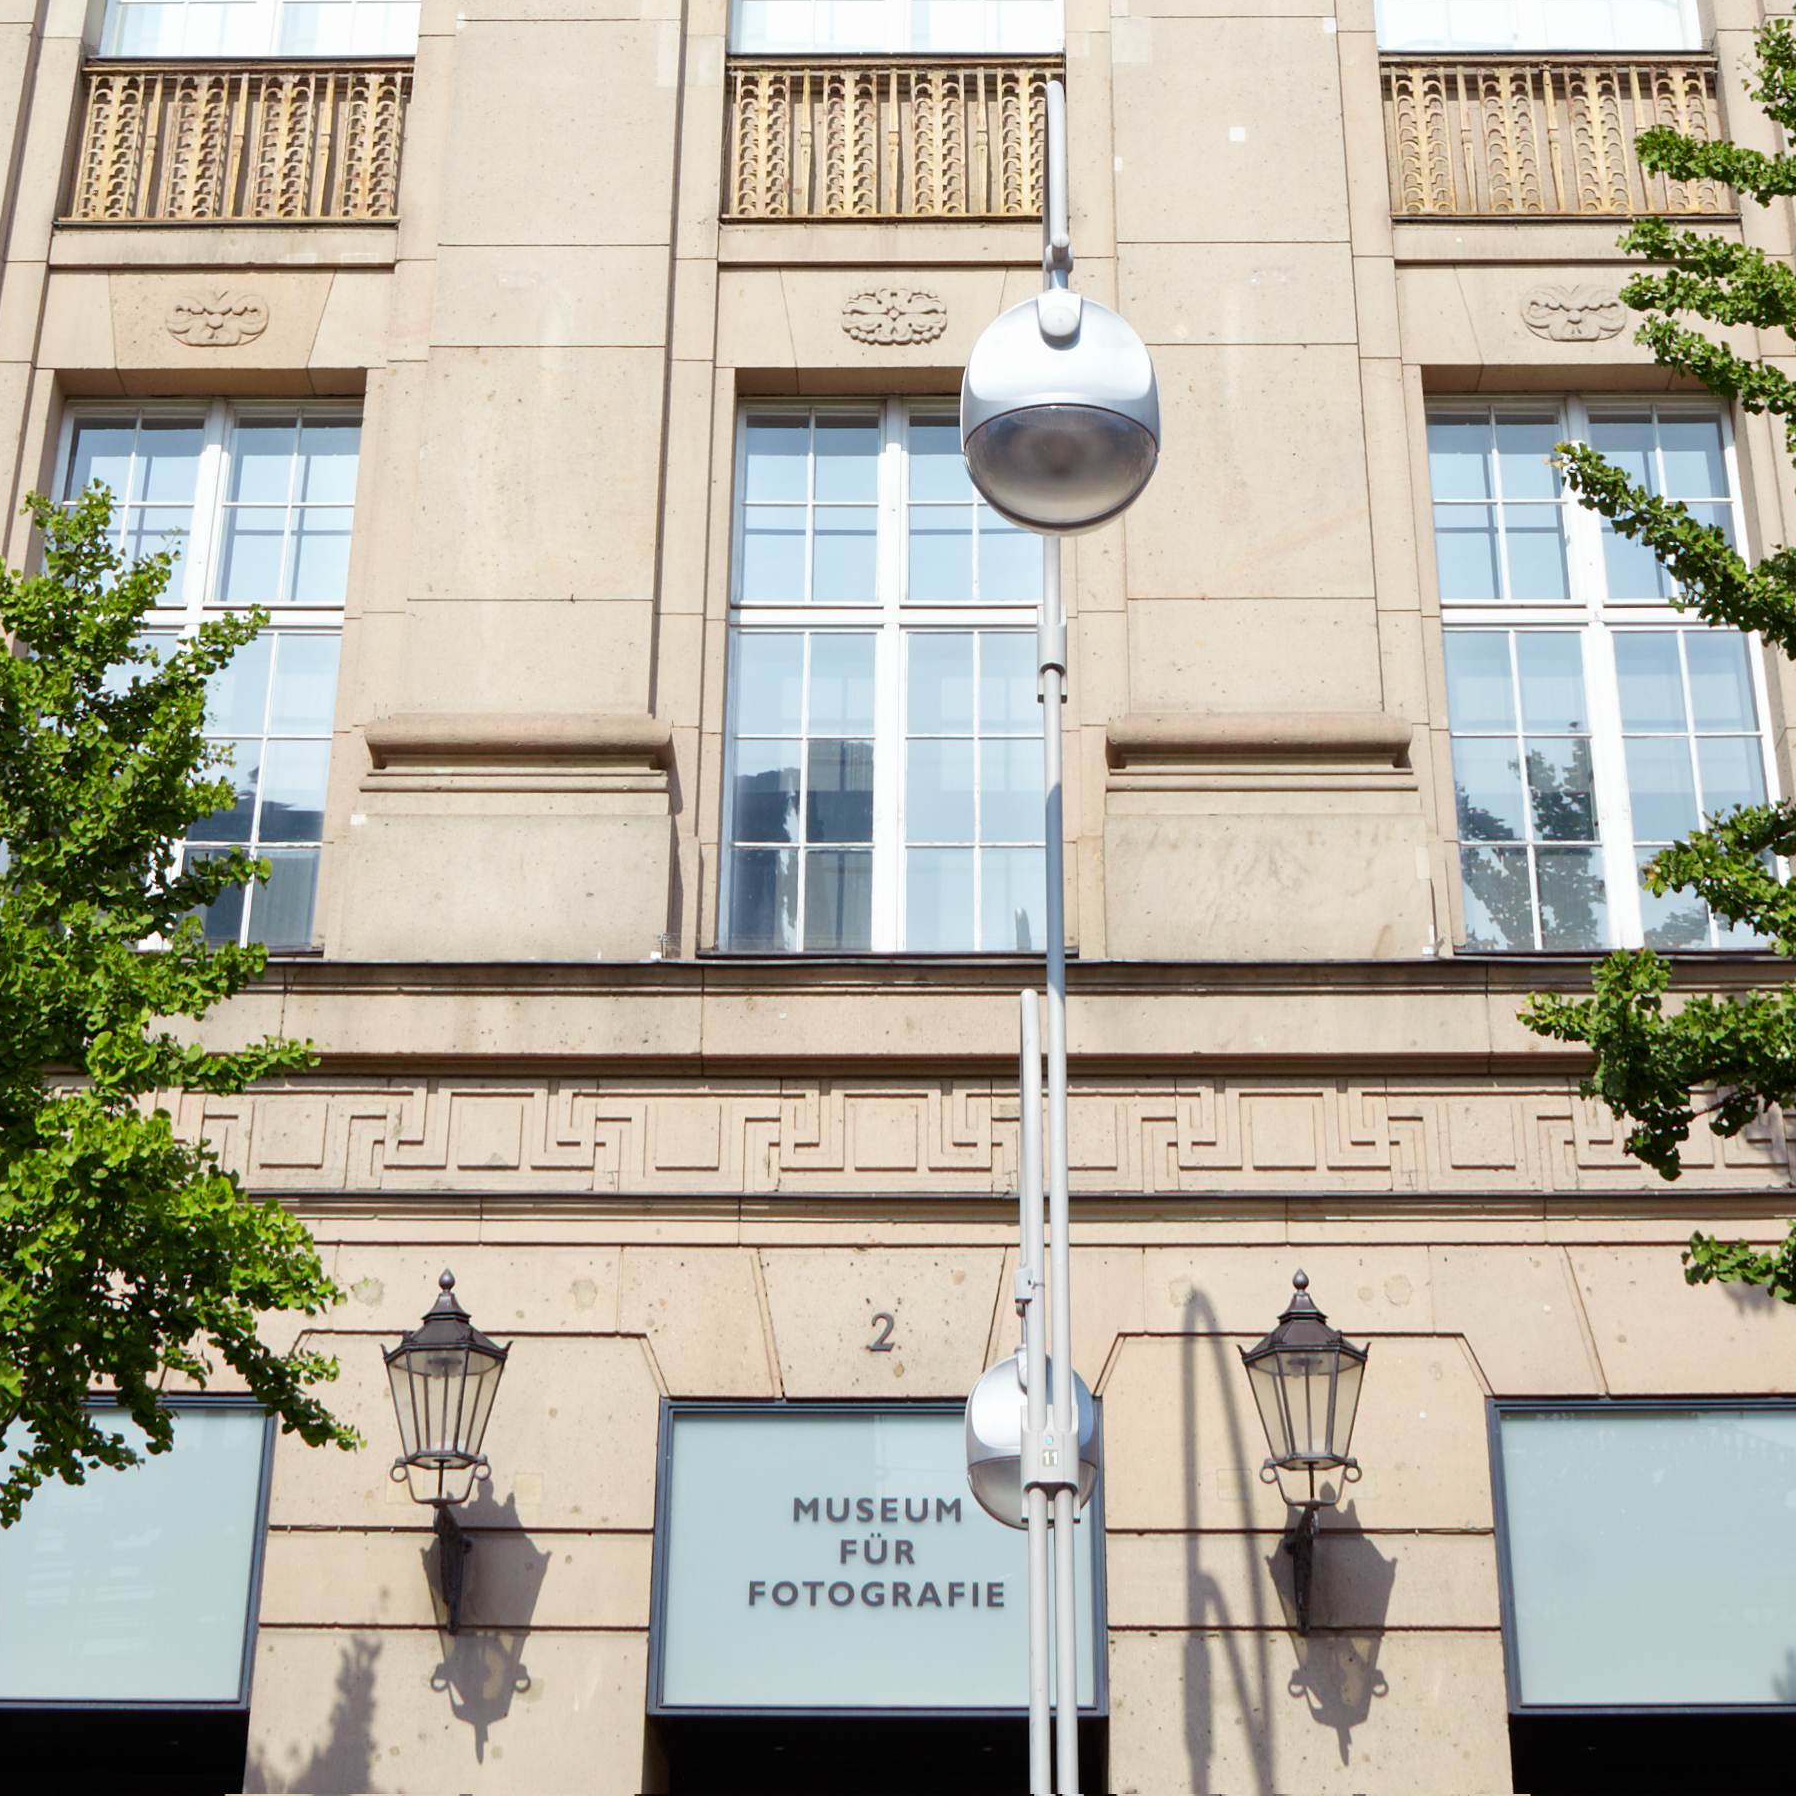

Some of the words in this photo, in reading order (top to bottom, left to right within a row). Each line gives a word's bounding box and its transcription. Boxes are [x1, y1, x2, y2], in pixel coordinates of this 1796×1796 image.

[870, 1313, 895, 1352] 2
[1042, 1450, 1059, 1466] 11
[794, 1498, 961, 1523] MUSEUM
[840, 1533, 916, 1565] FÜR
[749, 1581, 1004, 1607] FOTOGRAFIE
